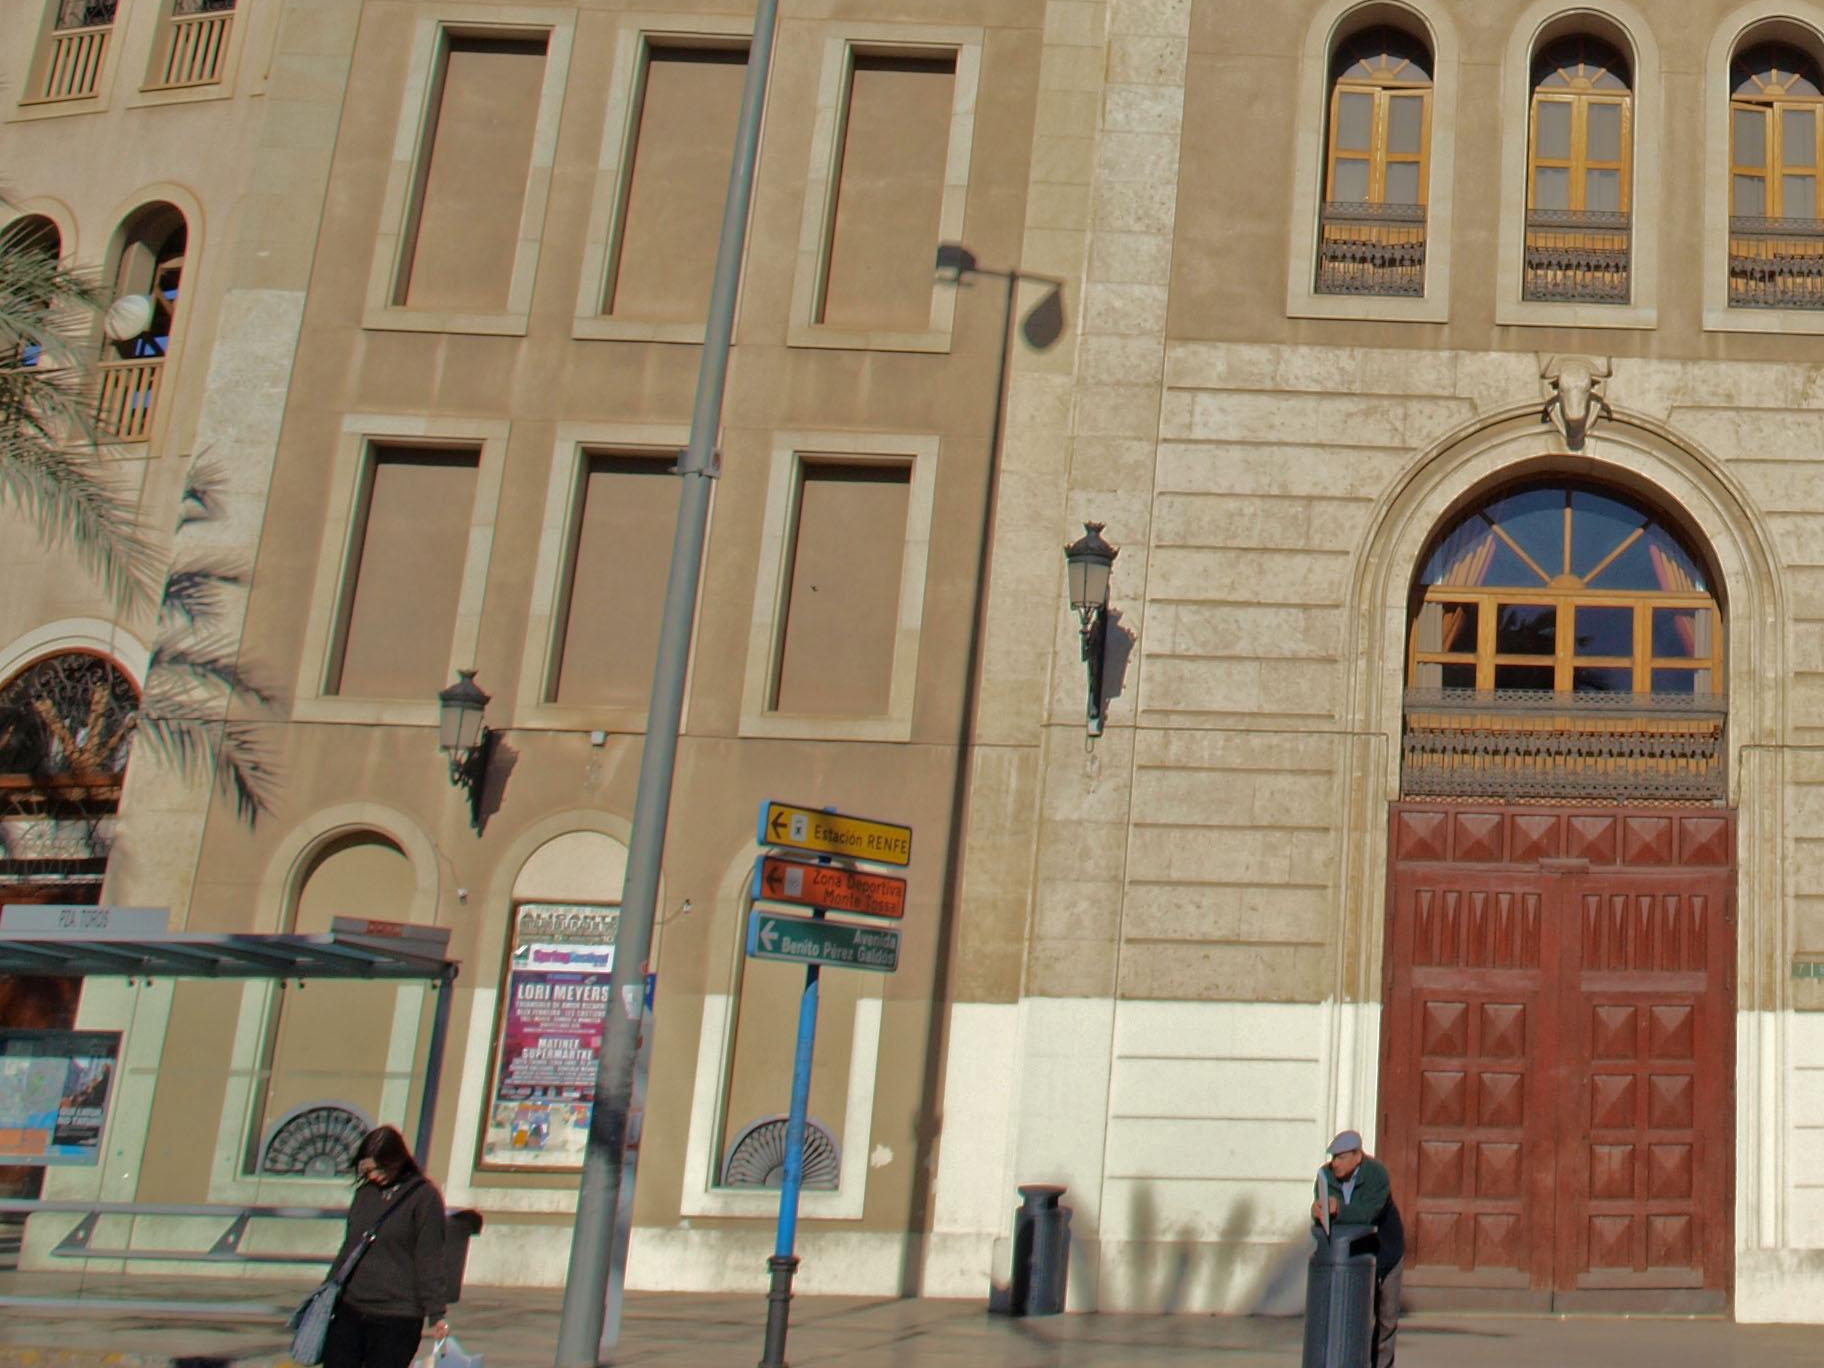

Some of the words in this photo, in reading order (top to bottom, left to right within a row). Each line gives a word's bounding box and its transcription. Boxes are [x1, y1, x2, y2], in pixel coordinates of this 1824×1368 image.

[814, 825, 863, 846] Estación
[867, 835, 908, 854] RENFE
[813, 869, 841, 889] Zona
[847, 874, 902, 897] Deportiva
[781, 937, 820, 957] Benito
[853, 930, 897, 948] Avenida
[518, 984, 550, 1001] LORI
[553, 985, 609, 1002] MEYERS
